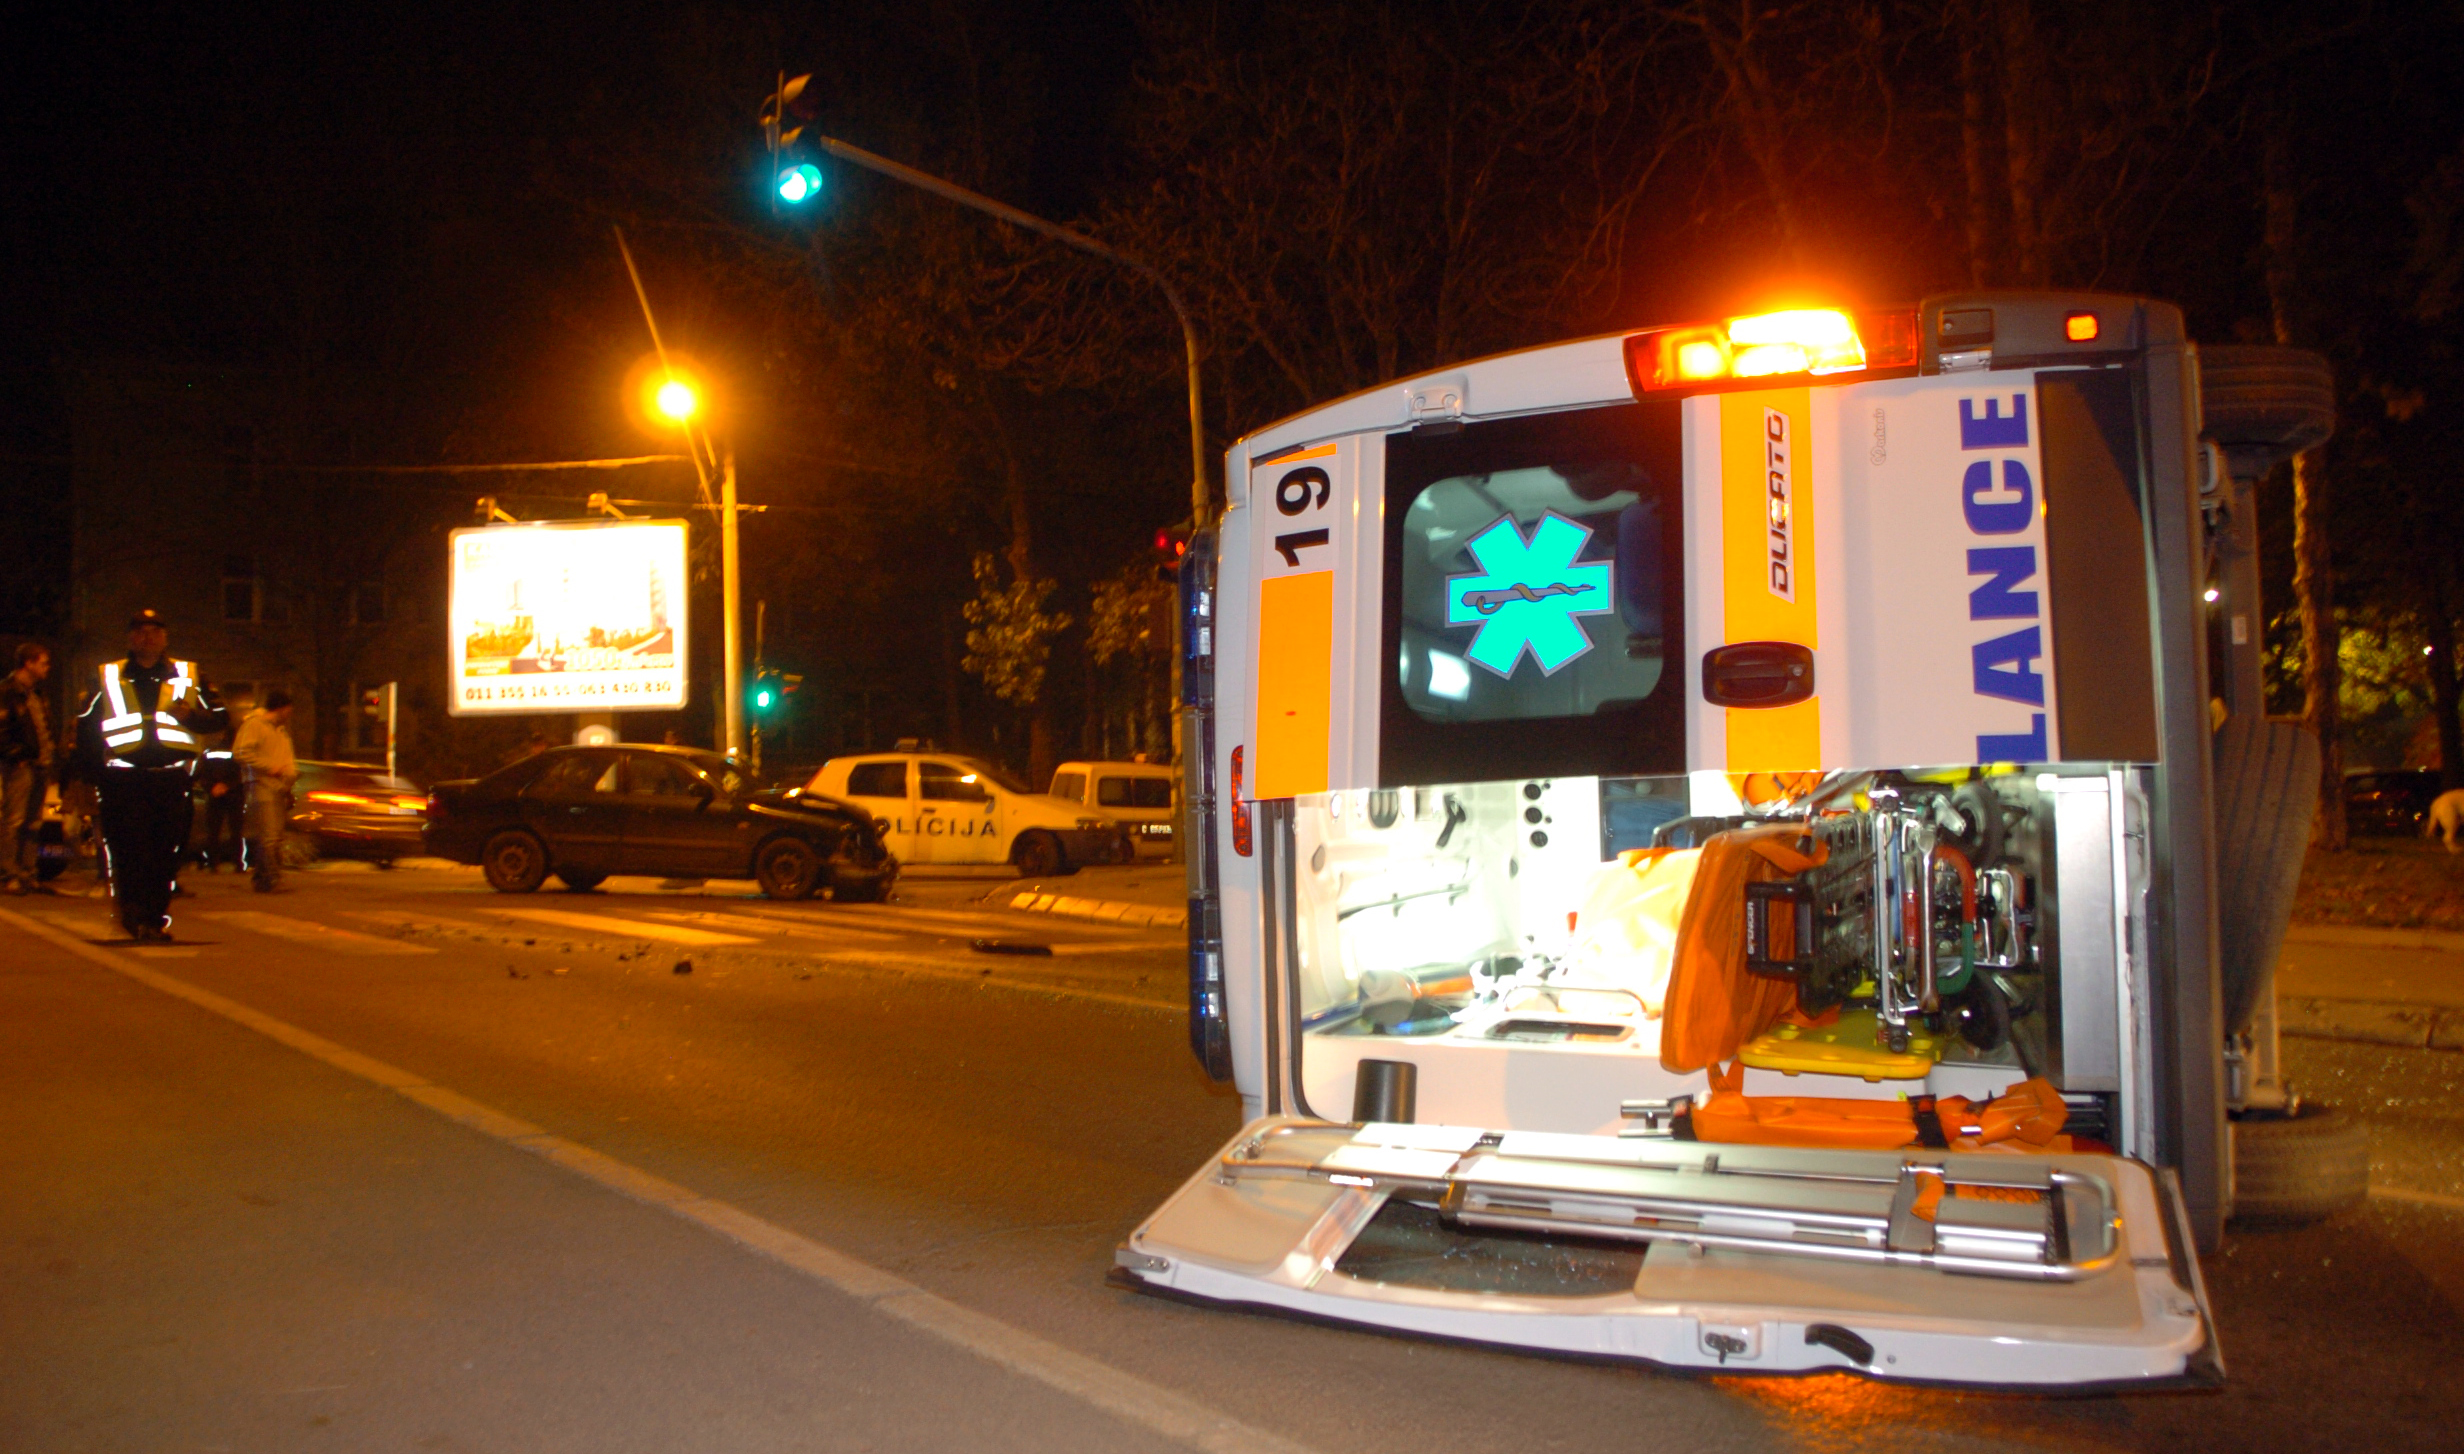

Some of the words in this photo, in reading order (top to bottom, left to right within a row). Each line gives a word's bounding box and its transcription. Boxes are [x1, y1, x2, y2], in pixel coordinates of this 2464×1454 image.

[1274, 466, 1331, 567] 19
[1765, 412, 1790, 594] DUCATO
[1958, 393, 2048, 763] LANCE
[465, 686, 492, 701] 011
